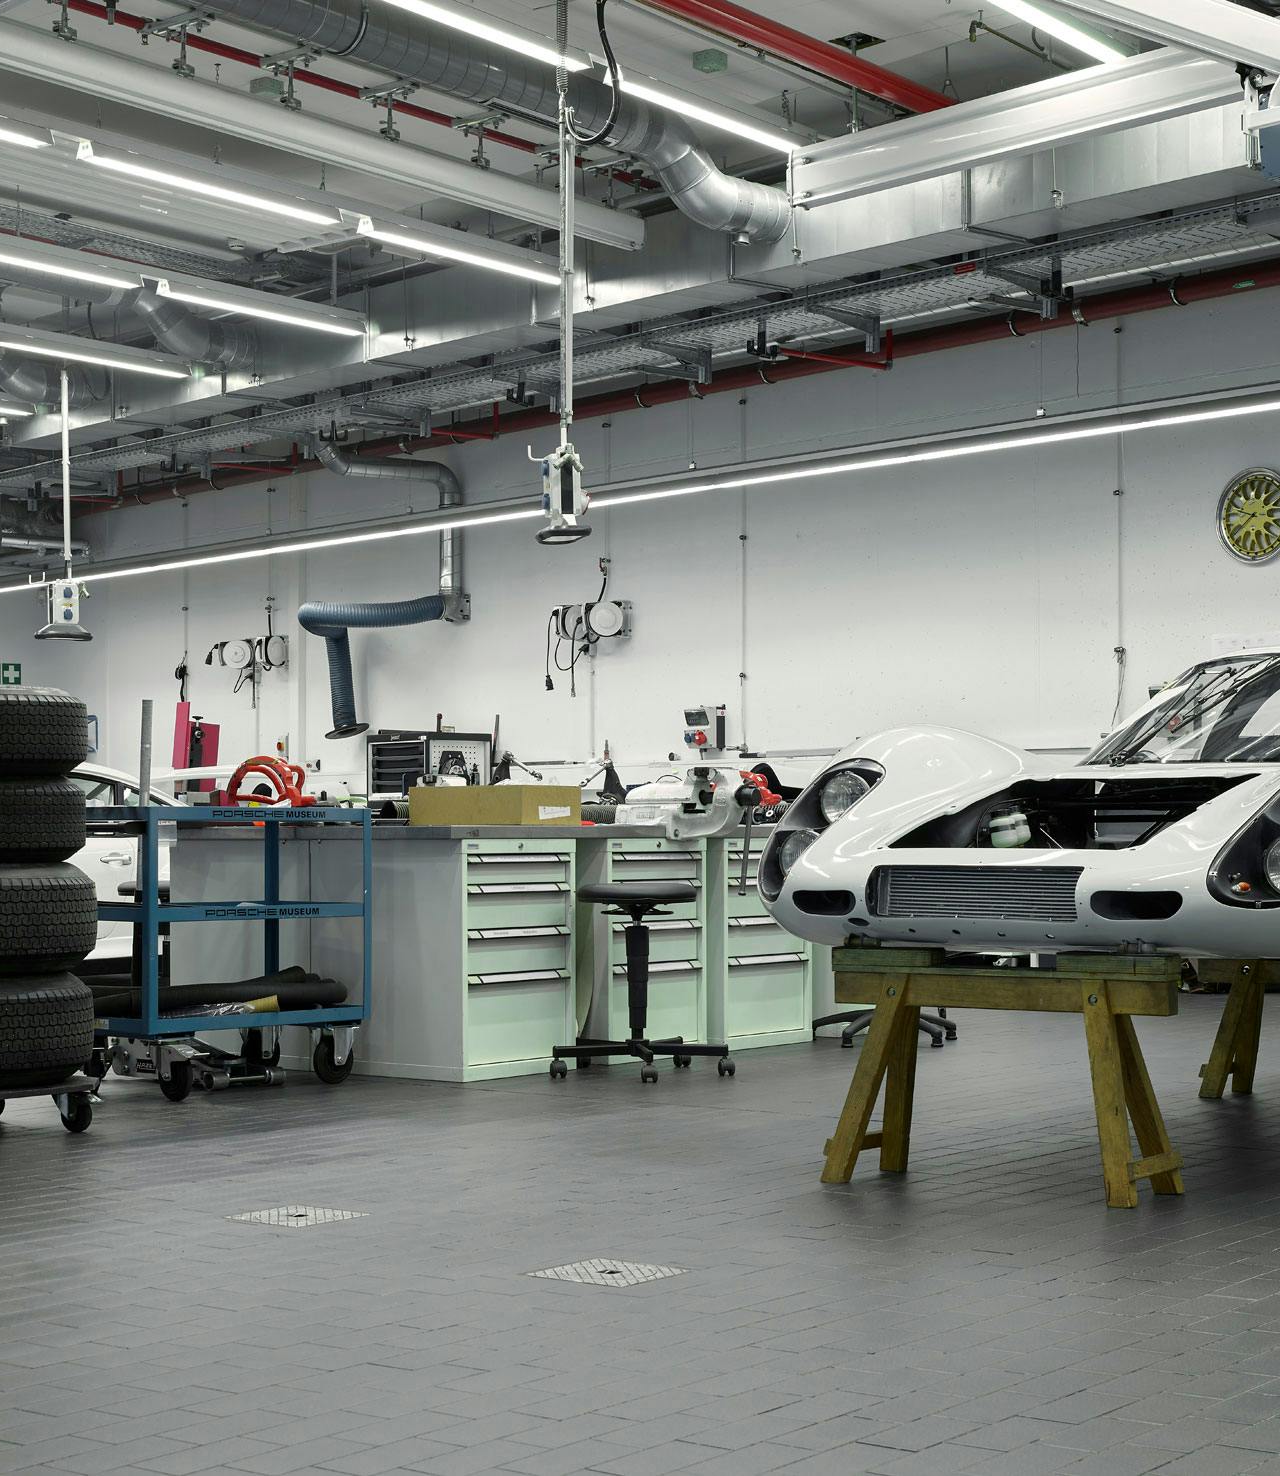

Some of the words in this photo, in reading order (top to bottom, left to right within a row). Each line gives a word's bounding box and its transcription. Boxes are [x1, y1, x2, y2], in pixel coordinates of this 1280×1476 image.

[212, 810, 285, 818] PORSCHE
[286, 810, 326, 818] MUSEUM
[205, 908, 278, 917] PORSCHE
[279, 907, 320, 916] MUSEUM
